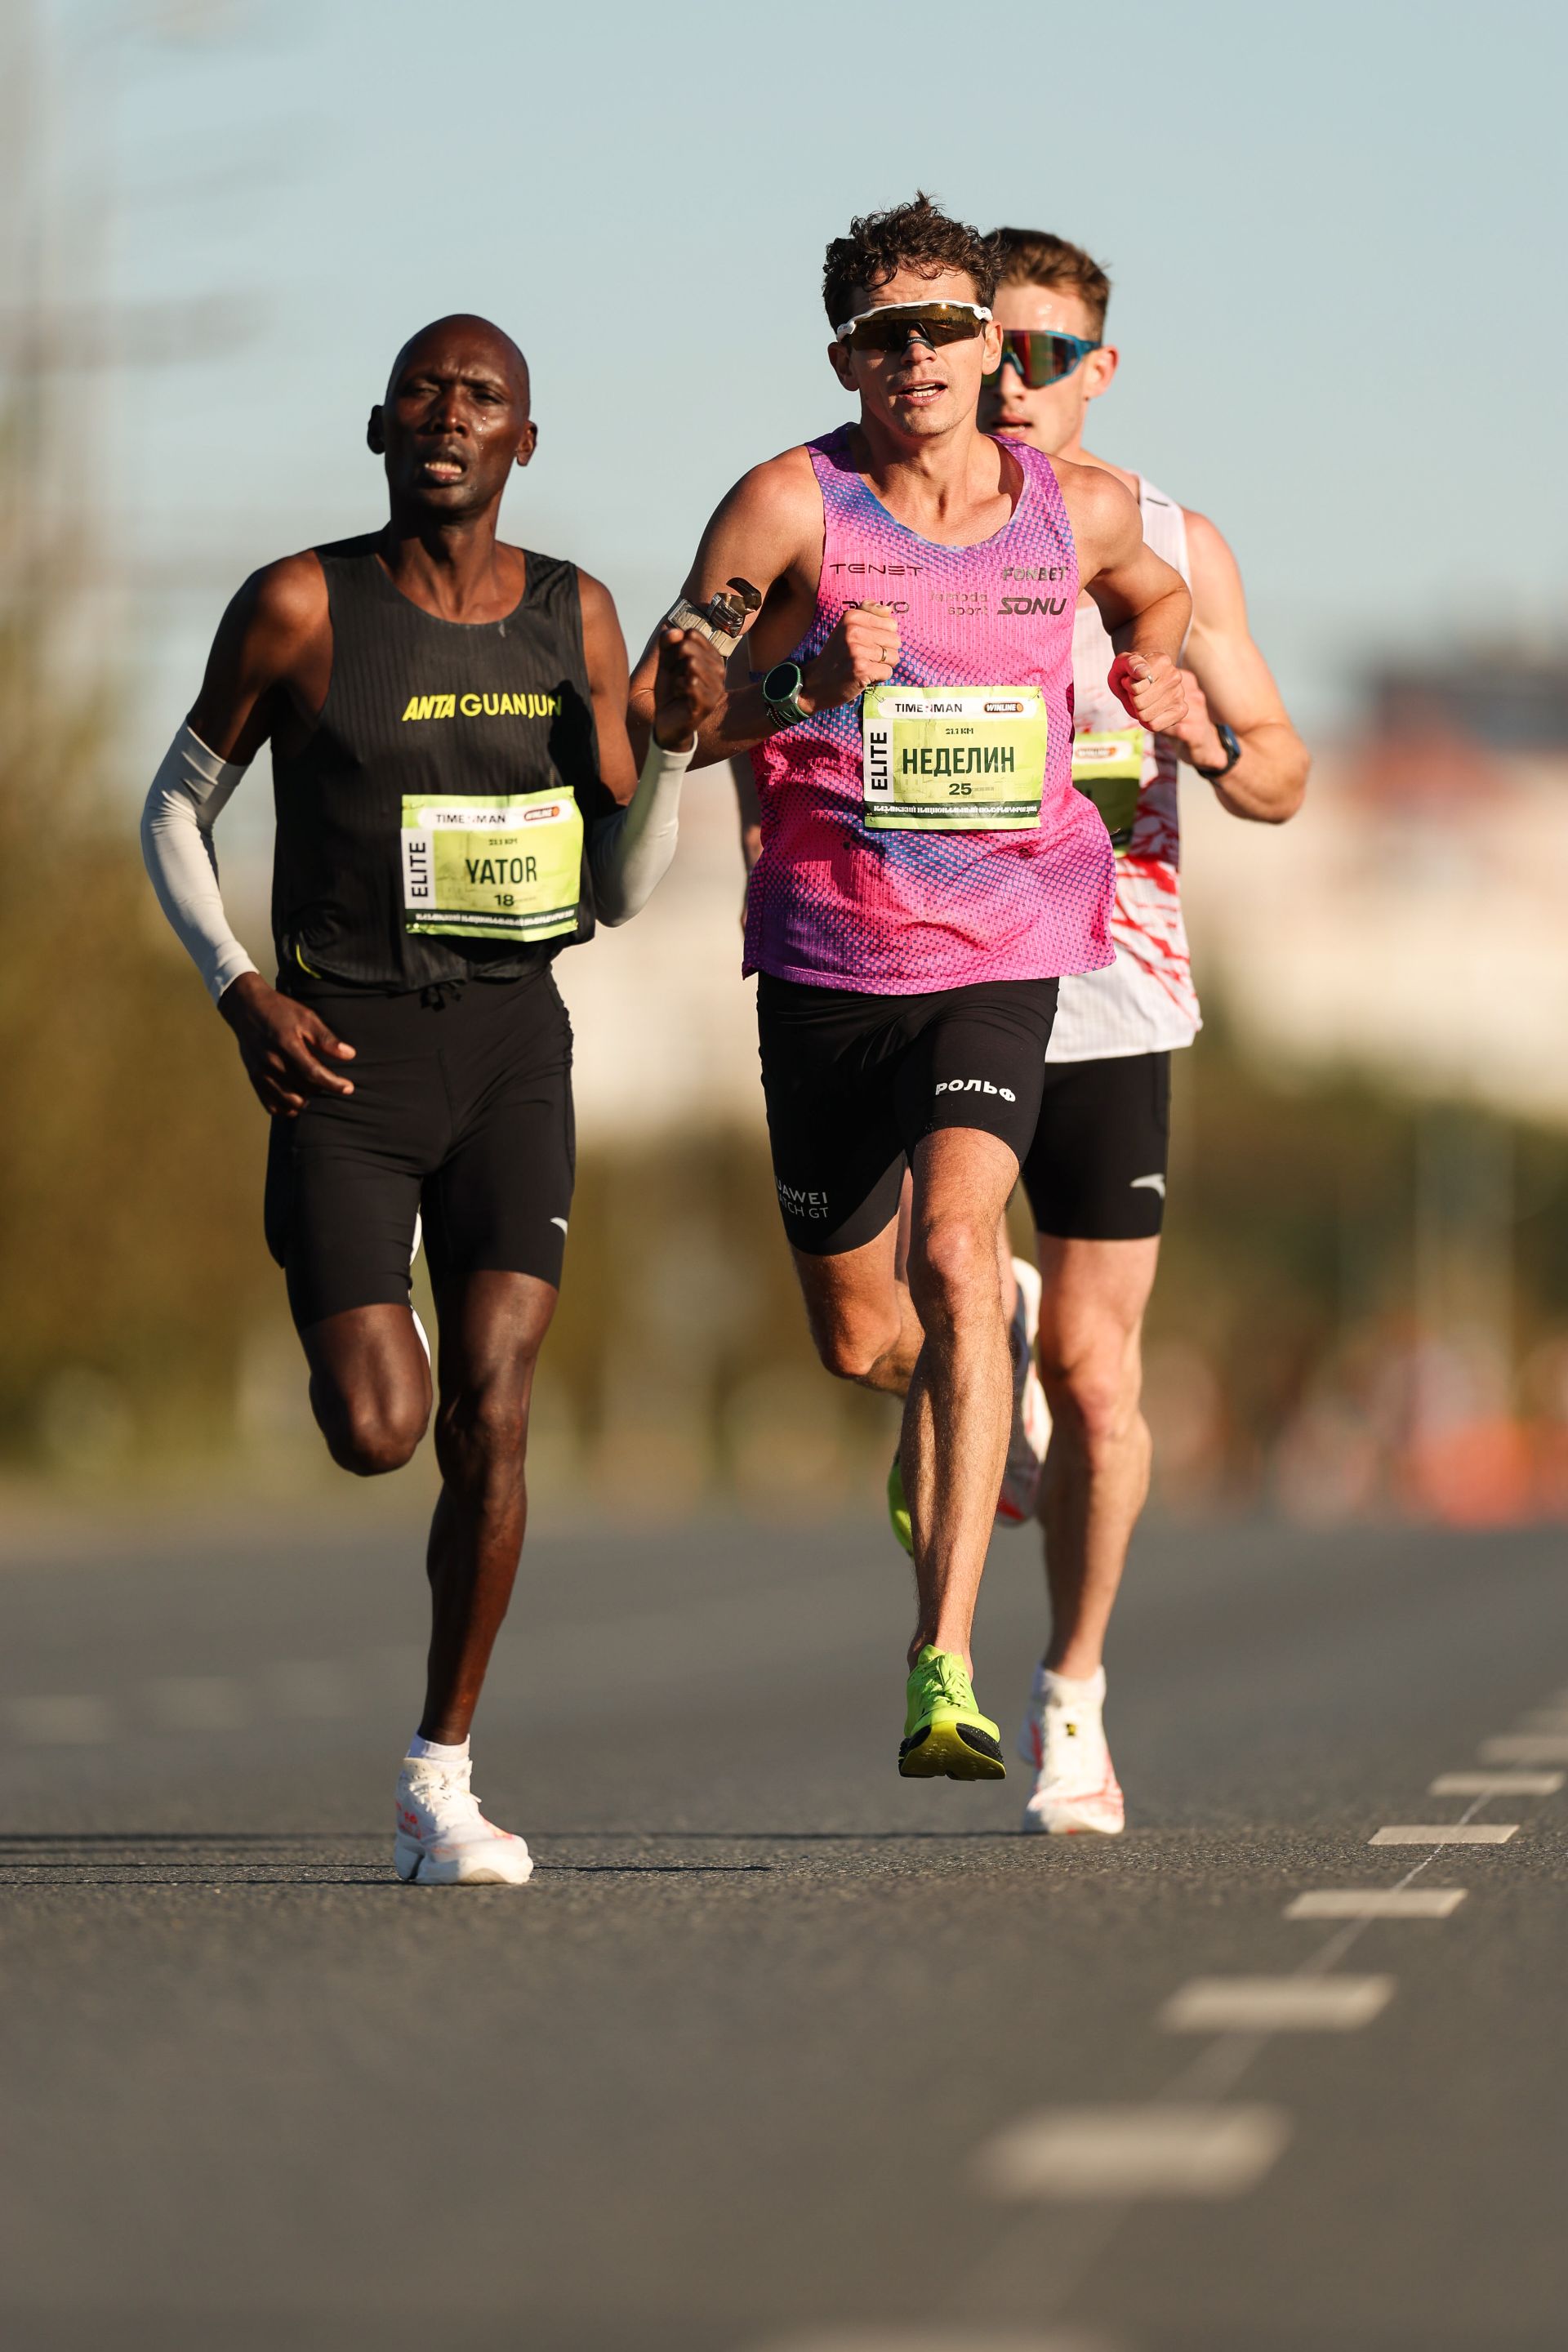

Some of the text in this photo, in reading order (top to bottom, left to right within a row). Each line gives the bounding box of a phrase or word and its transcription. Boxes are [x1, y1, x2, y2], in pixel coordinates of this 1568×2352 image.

[829, 563, 924, 577] TENET
[1003, 566, 1069, 581] FONBET
[947, 606, 988, 616] sport
[997, 597, 1067, 615] SONU
[401, 693, 562, 722] ANTA GUANJUN
[895, 702, 963, 713] TIMEMAN
[871, 732, 889, 791] ELITE
[902, 746, 1014, 777] НЕДЕЛИН
[948, 782, 972, 795] 25
[436, 813, 506, 824] TIMEMAN
[409, 842, 429, 898] ELITE
[465, 857, 537, 884] YATOR
[494, 894, 514, 906] 18
[935, 1079, 1016, 1102] РОЛЬФ
[775, 1176, 828, 1205] UAWEI
[808, 1206, 829, 1218] GT
